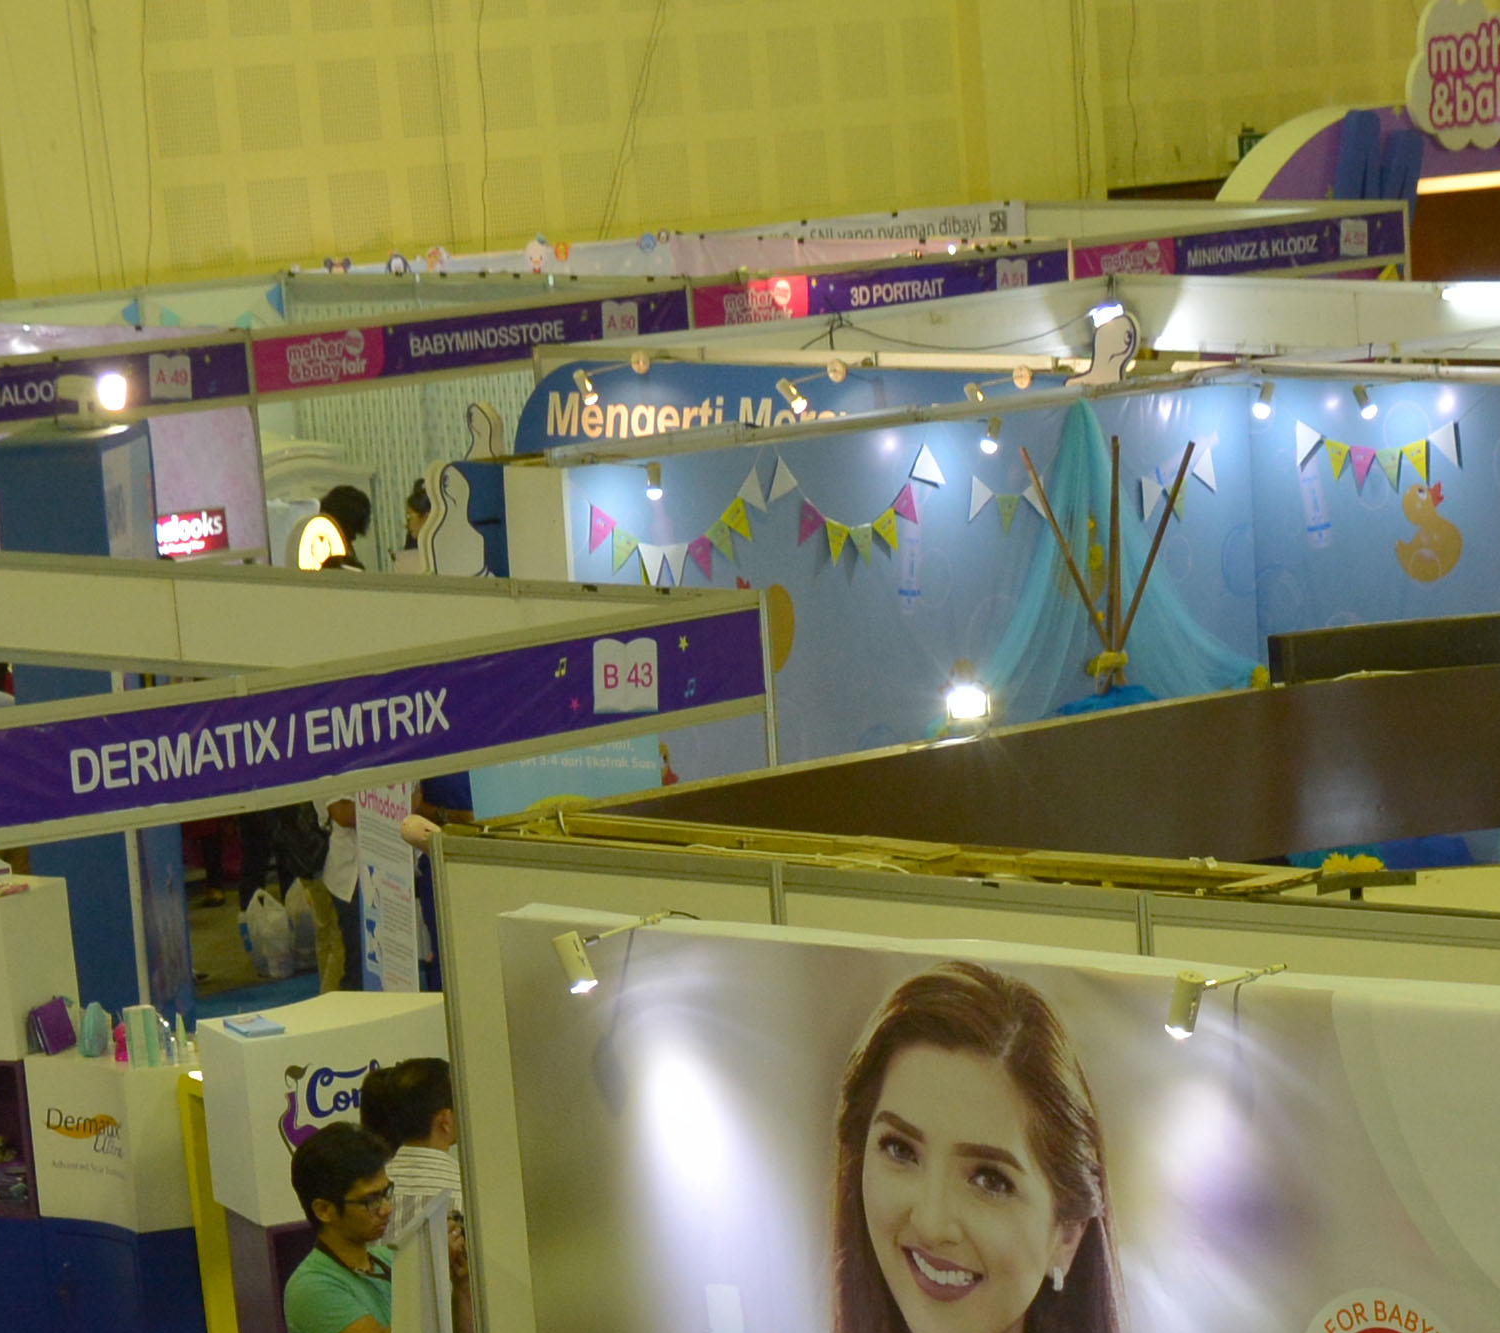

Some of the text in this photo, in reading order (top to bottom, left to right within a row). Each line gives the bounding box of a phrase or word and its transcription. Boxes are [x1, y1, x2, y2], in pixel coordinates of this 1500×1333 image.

[850, 277, 945, 306] 3D PORTRAIT
[409, 319, 566, 357] BABYMINDSSTORE
[171, 367, 189, 385] 49
[627, 660, 654, 687] 43
[70, 688, 450, 795] DERMATIX / EMTRIX
